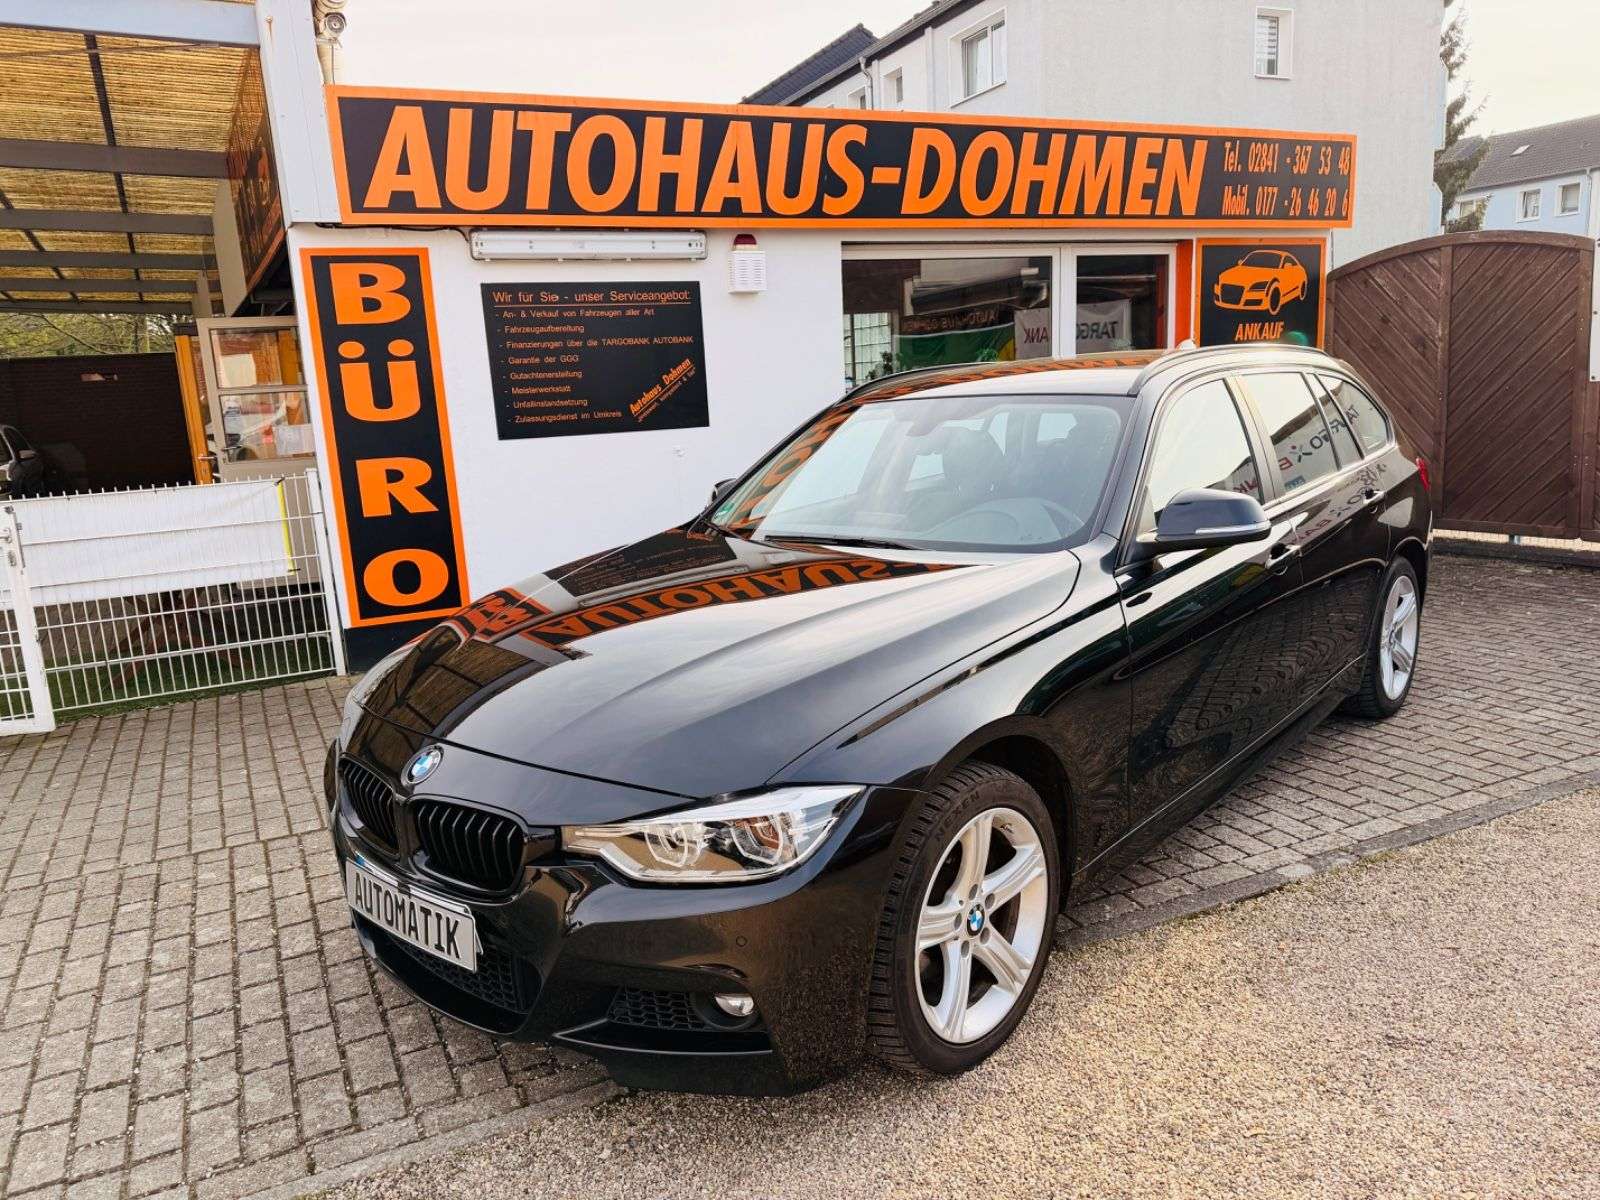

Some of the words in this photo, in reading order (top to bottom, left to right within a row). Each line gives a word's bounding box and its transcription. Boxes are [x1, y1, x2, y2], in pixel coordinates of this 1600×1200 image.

[363, 105, 1208, 216] AUTOHAUS-DOHMEN
[1224, 140, 1241, 173] Tel.
[1248, 141, 1279, 173] 02841
[1318, 146, 1332, 175] 53
[1338, 146, 1350, 176] 48
[1222, 184, 1250, 216] Mobil.
[1255, 186, 1280, 216] 0177
[1307, 187, 1319, 216] 46
[1324, 187, 1337, 216] 20
[492, 291, 512, 303] Wir
[519, 291, 533, 302] für
[540, 291, 559, 302] Sie
[575, 292, 604, 302] unser
[530, 310, 559, 318] Verkauf
[580, 309, 622, 318] Fahrzeugen
[644, 308, 656, 316] Art
[504, 324, 585, 334] Fahrzeugaufbereitung
[1234, 320, 1285, 341] ANKAUF
[506, 340, 563, 350] Finanzierungen
[566, 339, 583, 348] über
[587, 339, 599, 347] die
[602, 337, 650, 347] TARGOBANK
[653, 336, 694, 345] AUTOBANK
[508, 356, 541, 365] Garantie
[544, 355, 557, 364] der
[510, 370, 583, 380] Gutachtenerstellung
[511, 385, 572, 394] Meisterwerkstatt
[629, 384, 662, 416] Autohaus
[662, 358, 691, 385] Dohmen
[513, 399, 588, 409] Unfallinstandsetzung
[515, 413, 578, 424] Zulassungsdienst
[593, 409, 622, 419] Umkreis
[329, 262, 449, 607] BÜRO
[355, 871, 462, 959] AUTOMATIK
